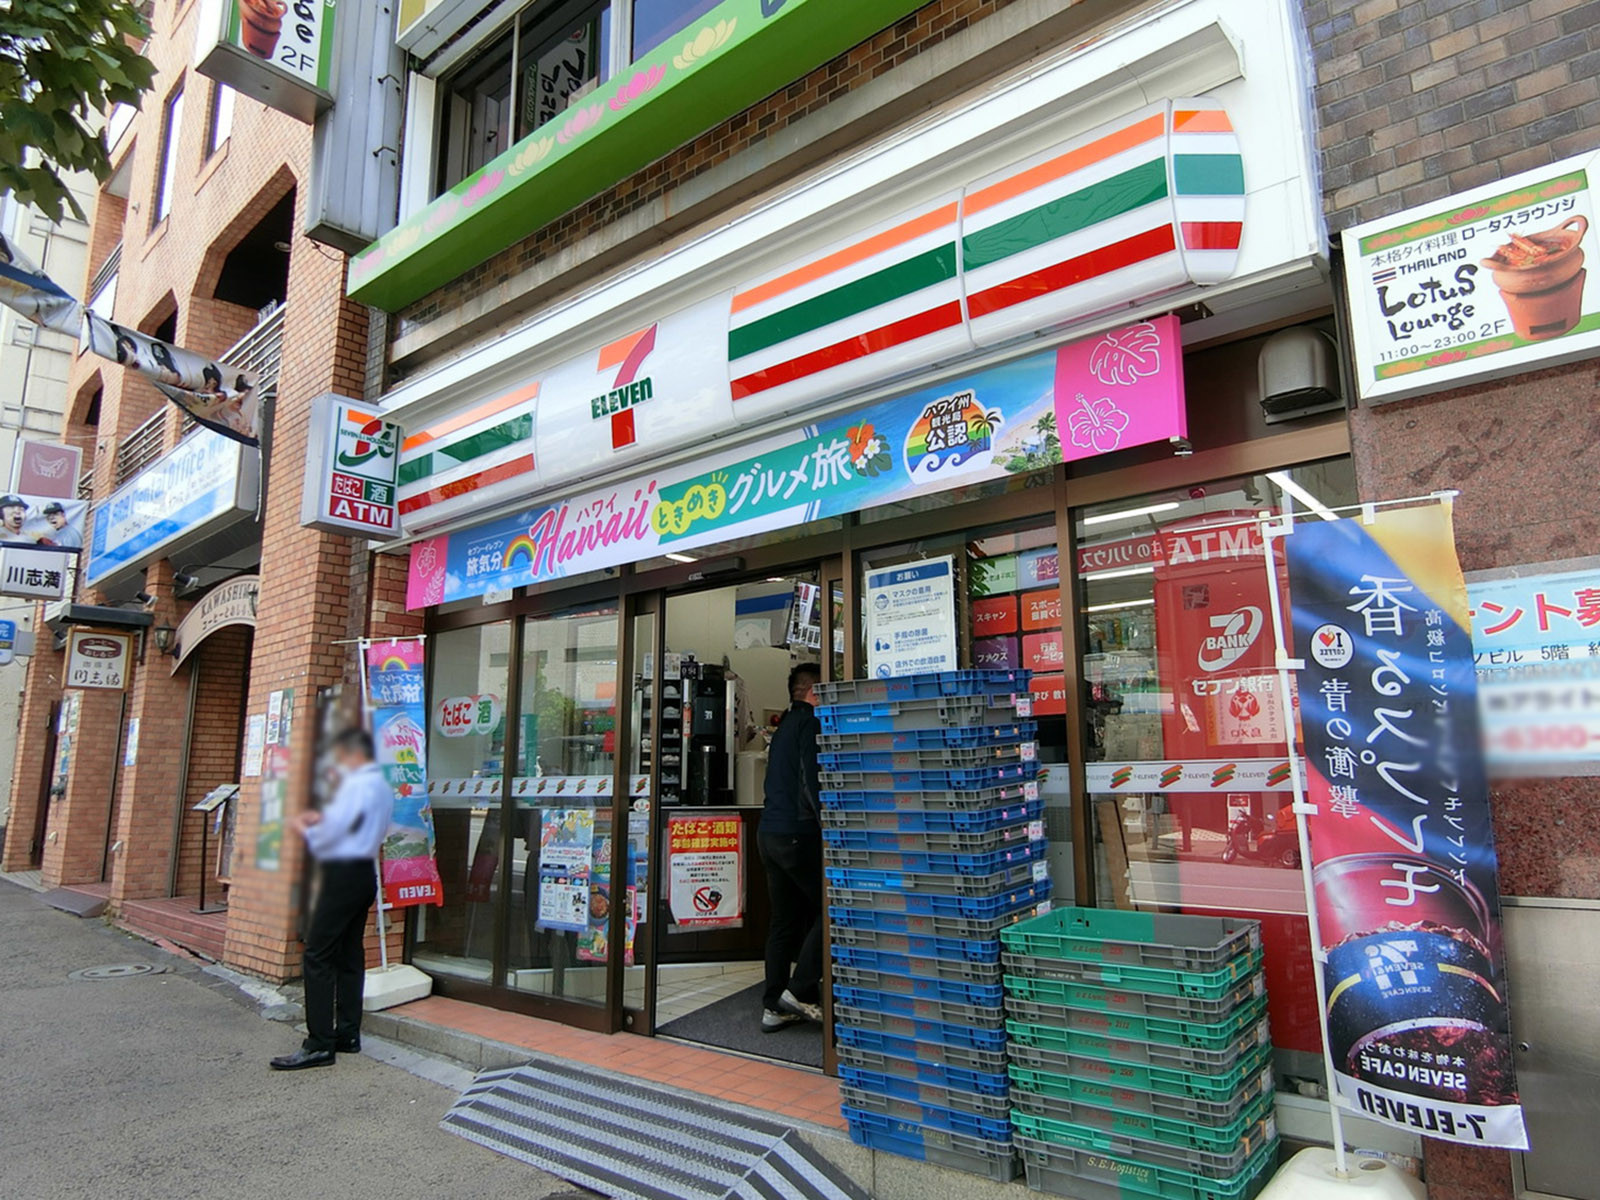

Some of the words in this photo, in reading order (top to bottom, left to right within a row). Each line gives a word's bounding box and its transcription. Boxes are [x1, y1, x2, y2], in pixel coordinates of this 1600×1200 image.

[281, 45, 315, 71] 2F
[1370, 232, 1459, 268] 本格タイ料理
[1462, 196, 1576, 241] ロータスラウンジ
[1399, 248, 1467, 276] THAILAND
[1388, 303, 1475, 341] Lounge
[1480, 318, 1507, 338] 2F
[924, 393, 971, 418] ハワイ州
[931, 410, 962, 428] 観光局
[926, 420, 968, 453] 公認
[333, 476, 360, 496] たばこ
[370, 484, 388, 503] 酒
[658, 489, 719, 528] ときめき
[728, 437, 853, 515] グルメ旅
[335, 500, 389, 525] ATM
[576, 492, 618, 522] ハワイ
[530, 480, 657, 577] Hawaii
[1169, 528, 1250, 566] ATM
[466, 551, 502, 576] 旅気分
[896, 570, 919, 581] お願い
[6, 566, 61, 589] 川志満
[976, 611, 1007, 623] スキャン
[1206, 633, 1250, 650] BANK
[1541, 644, 1569, 661] 5階
[1192, 675, 1273, 696] セブン銀行
[442, 702, 471, 726] たばこ
[477, 700, 492, 724] 酒
